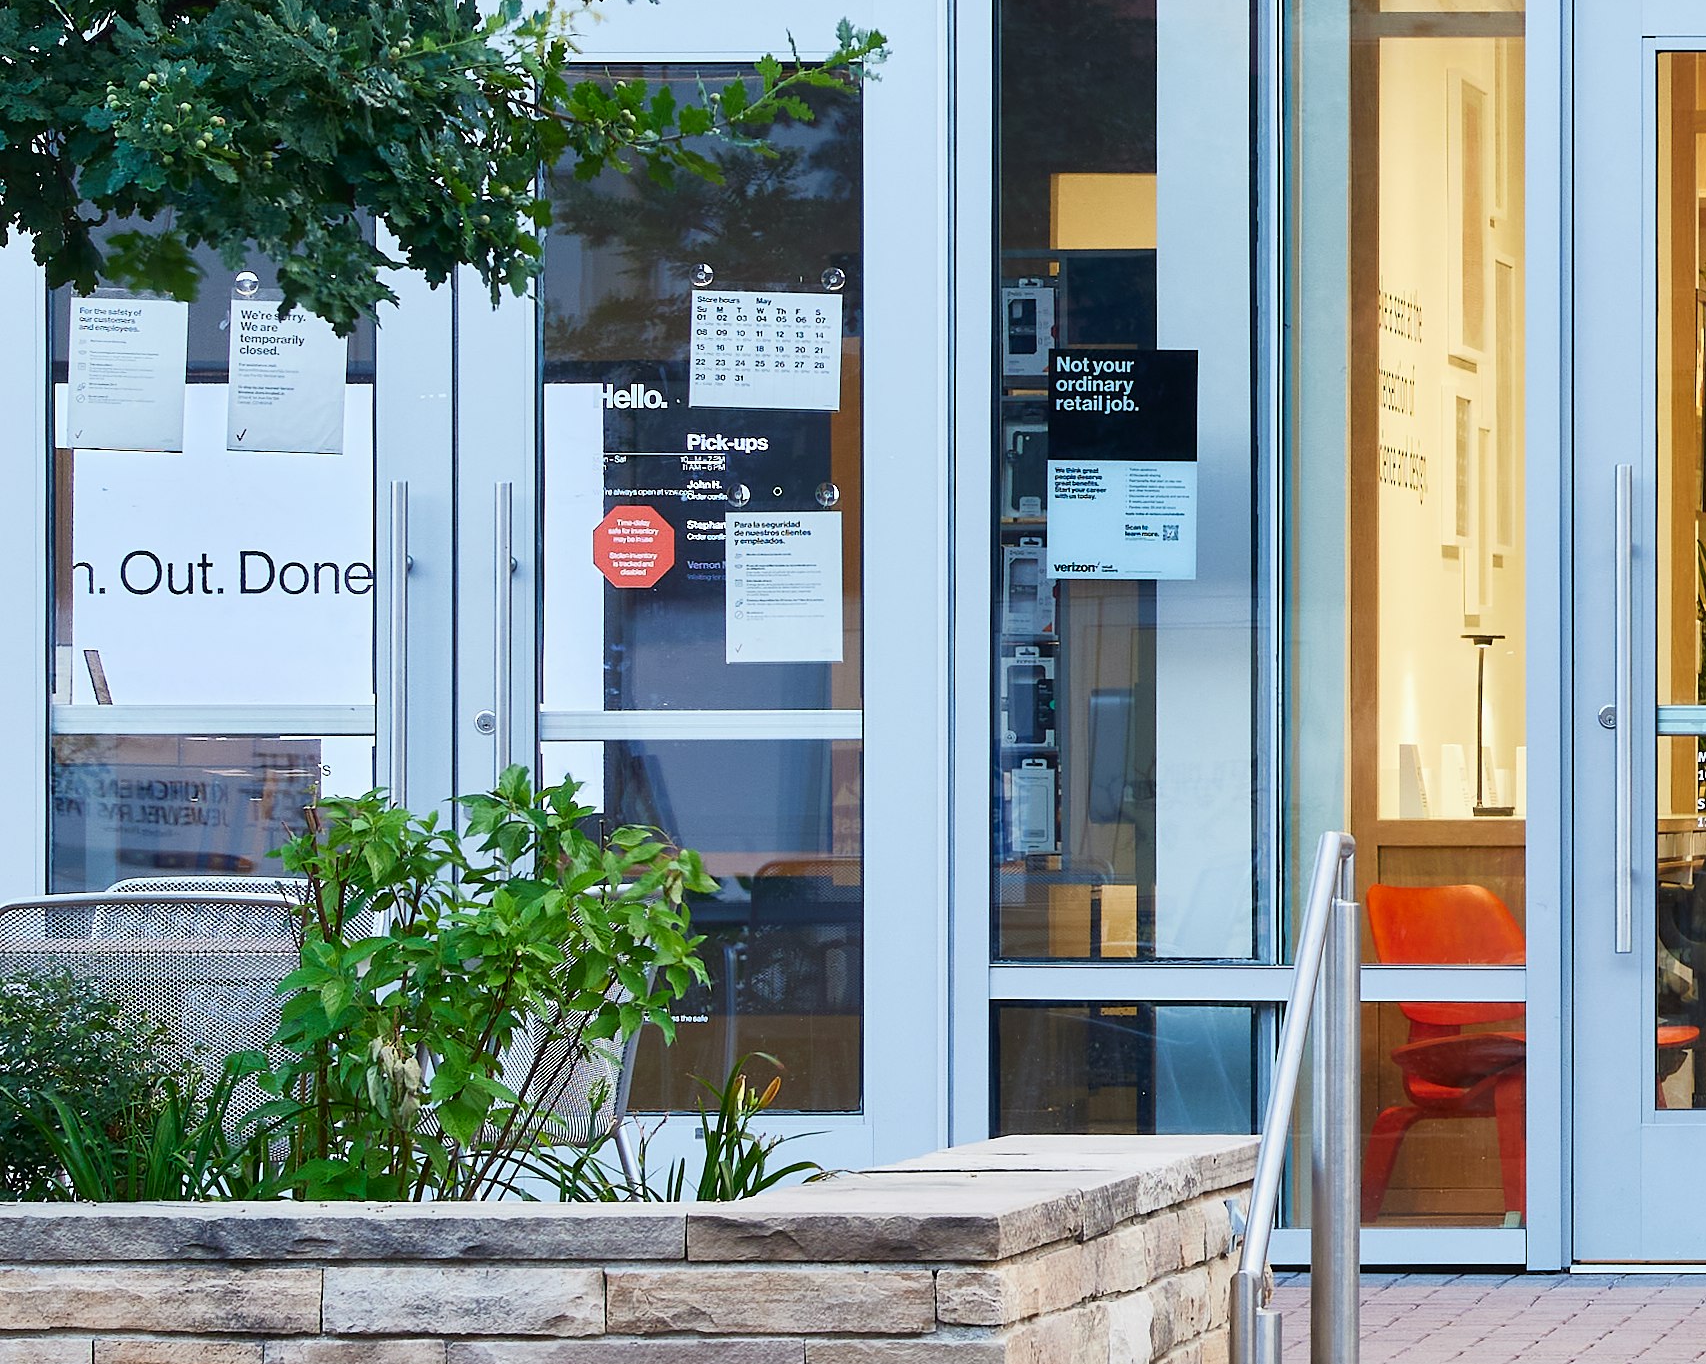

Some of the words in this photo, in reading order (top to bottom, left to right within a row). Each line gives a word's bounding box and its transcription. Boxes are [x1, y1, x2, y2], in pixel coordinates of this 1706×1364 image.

[718, 296, 741, 304] hours
[756, 297, 772, 306] May
[79, 307, 92, 315] For
[108, 309, 132, 317] safety
[240, 310, 273, 320] We're
[94, 316, 136, 324] customers
[78, 323, 93, 331] and
[95, 325, 140, 333] employees.
[240, 321, 258, 332] We
[260, 324, 278, 332] are
[240, 334, 305, 346] temporarily
[239, 345, 280, 356] closed.
[1056, 356, 1090, 373] Not
[1093, 360, 1135, 376] your
[1055, 375, 1134, 396] ordinary
[593, 383, 668, 409] Hello.
[1055, 395, 1103, 411] retail
[1104, 395, 1140, 415] job.
[687, 433, 769, 453] Pick-ups
[614, 455, 627, 463] Sat
[687, 480, 711, 490] John
[613, 489, 638, 497] always
[686, 493, 707, 501] Order
[1077, 493, 1097, 501] today.
[734, 521, 753, 529] Para
[753, 521, 761, 529] la
[761, 521, 801, 529] seguridad
[608, 527, 621, 535] safe
[621, 527, 630, 535] for
[630, 528, 659, 536] inventory
[734, 529, 745, 537] de
[745, 529, 780, 537] nuestros
[780, 529, 812, 537] clientes
[613, 536, 626, 544] may
[686, 533, 706, 541] Order
[740, 537, 786, 545] empleados.
[609, 552, 628, 560] Stolen
[628, 552, 658, 560] inventory
[618, 560, 641, 568] tracked
[687, 560, 720, 570] Vernon
[1053, 561, 1096, 573] verizon
[120, 550, 224, 596] Out.
[239, 550, 374, 595] Done
[680, 1015, 692, 1023] the
[692, 1015, 709, 1023] safe
